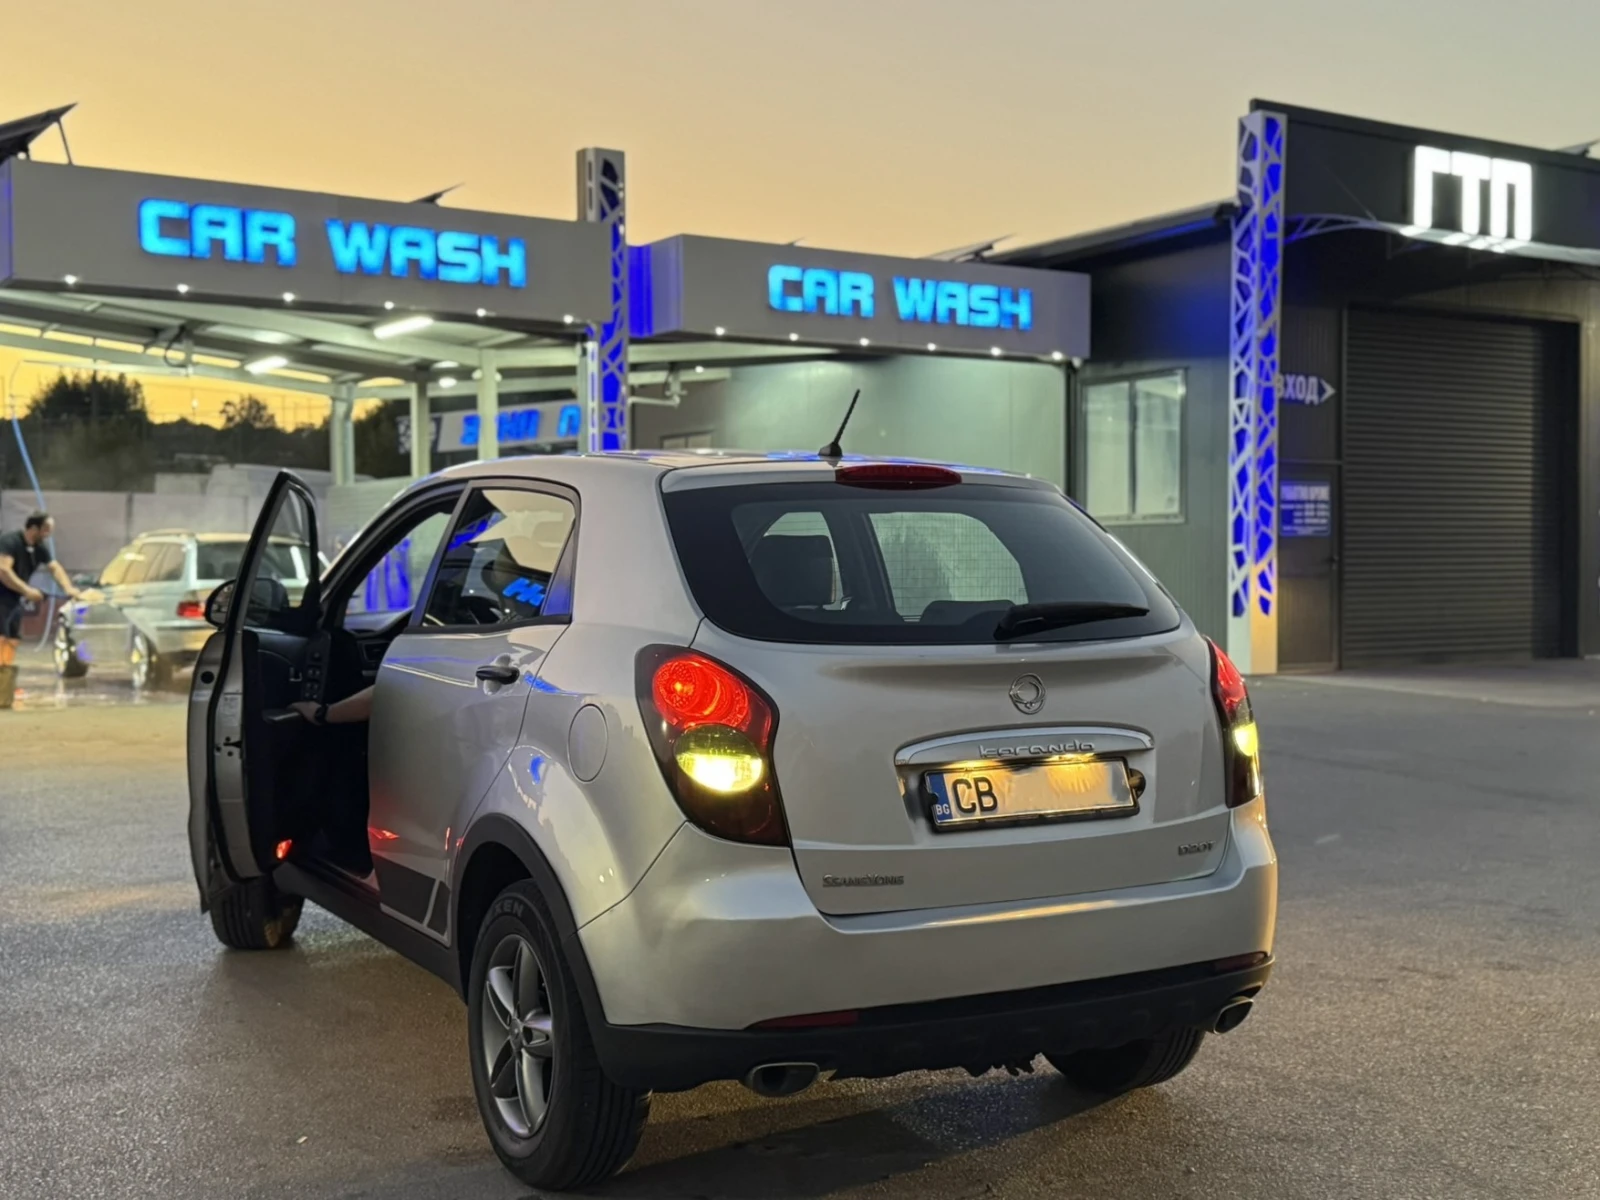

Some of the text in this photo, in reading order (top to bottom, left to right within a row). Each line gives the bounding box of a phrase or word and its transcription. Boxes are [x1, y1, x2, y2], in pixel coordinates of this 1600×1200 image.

[137, 198, 527, 289] CAR WASH
[767, 264, 1034, 332] CAR WASH
[935, 803, 951, 815] BG
[1178, 841, 1217, 857] D20T
